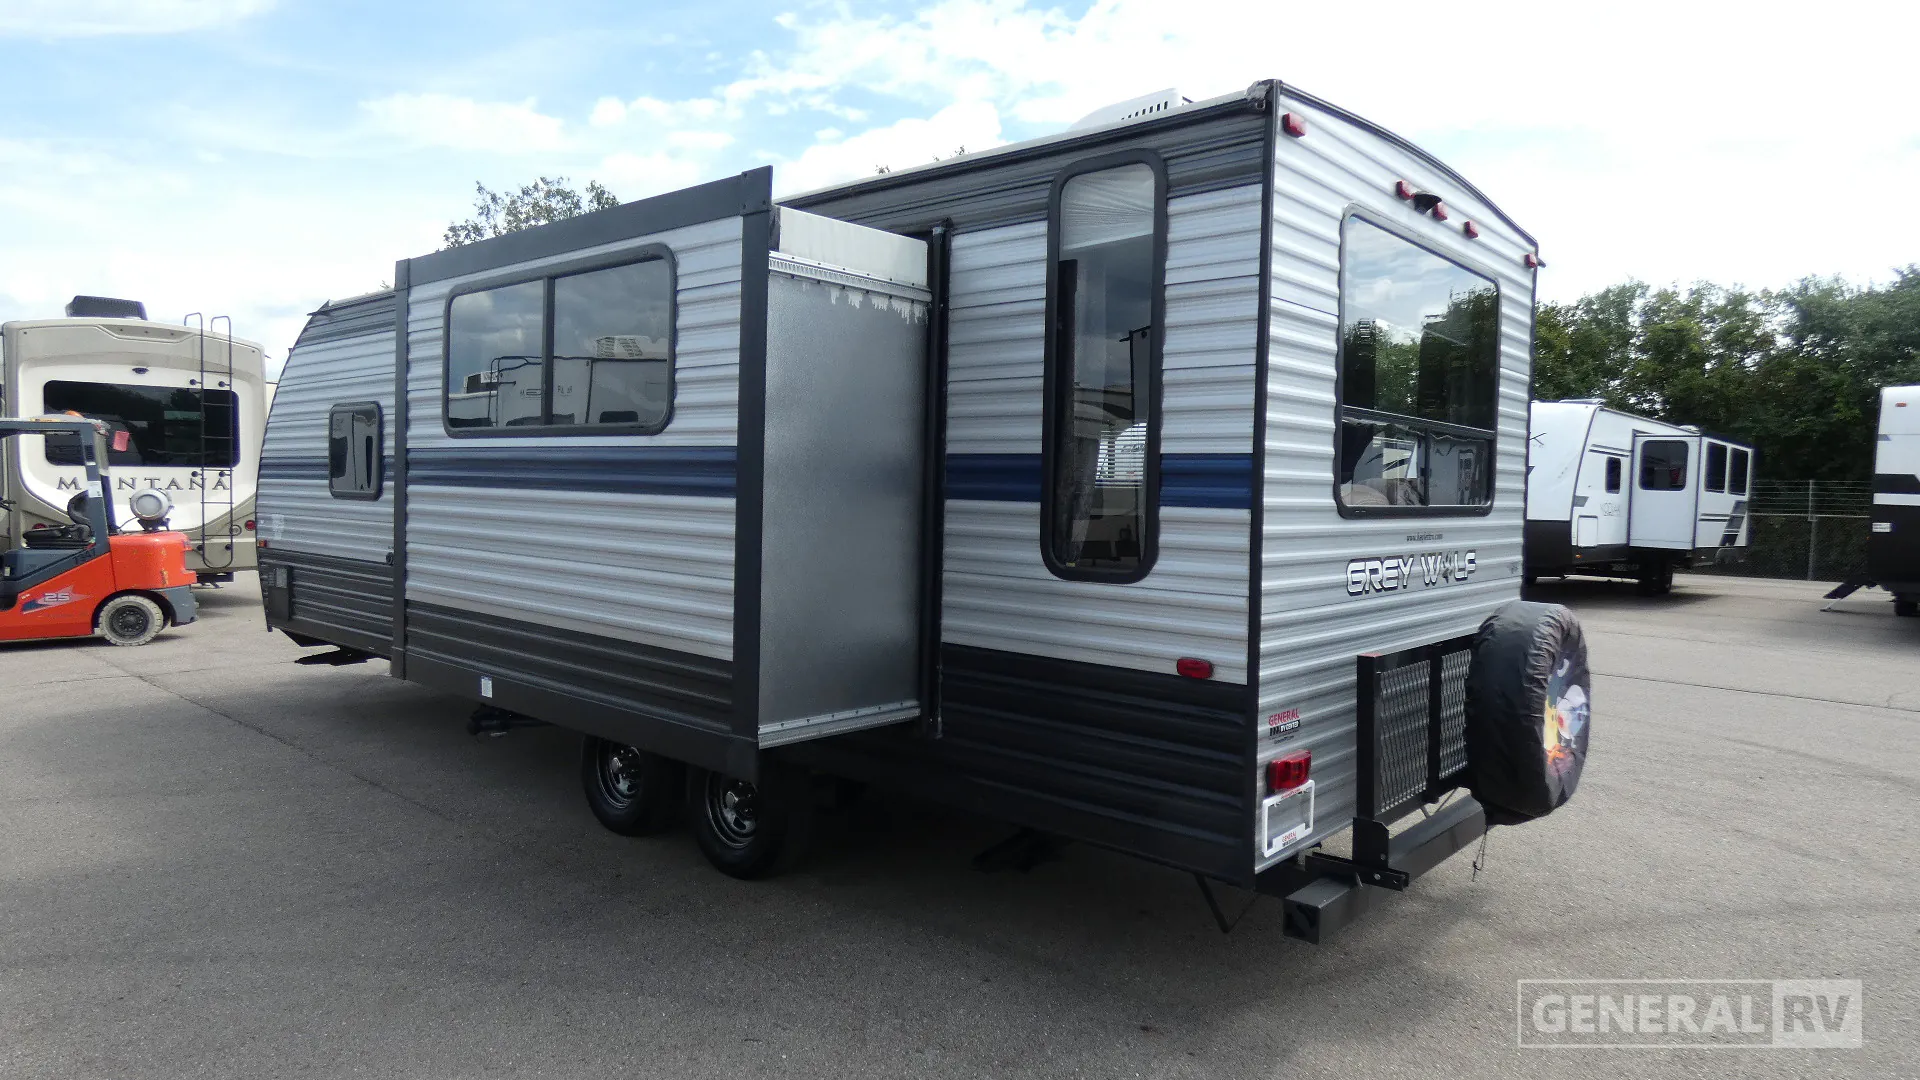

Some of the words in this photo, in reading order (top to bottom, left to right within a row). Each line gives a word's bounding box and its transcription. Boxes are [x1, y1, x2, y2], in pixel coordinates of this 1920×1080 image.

[56, 476, 230, 491] MNTANA
[1346, 554, 1414, 596] GREY
[44, 592, 71, 602] 25
[1268, 708, 1300, 727] GENERAL
